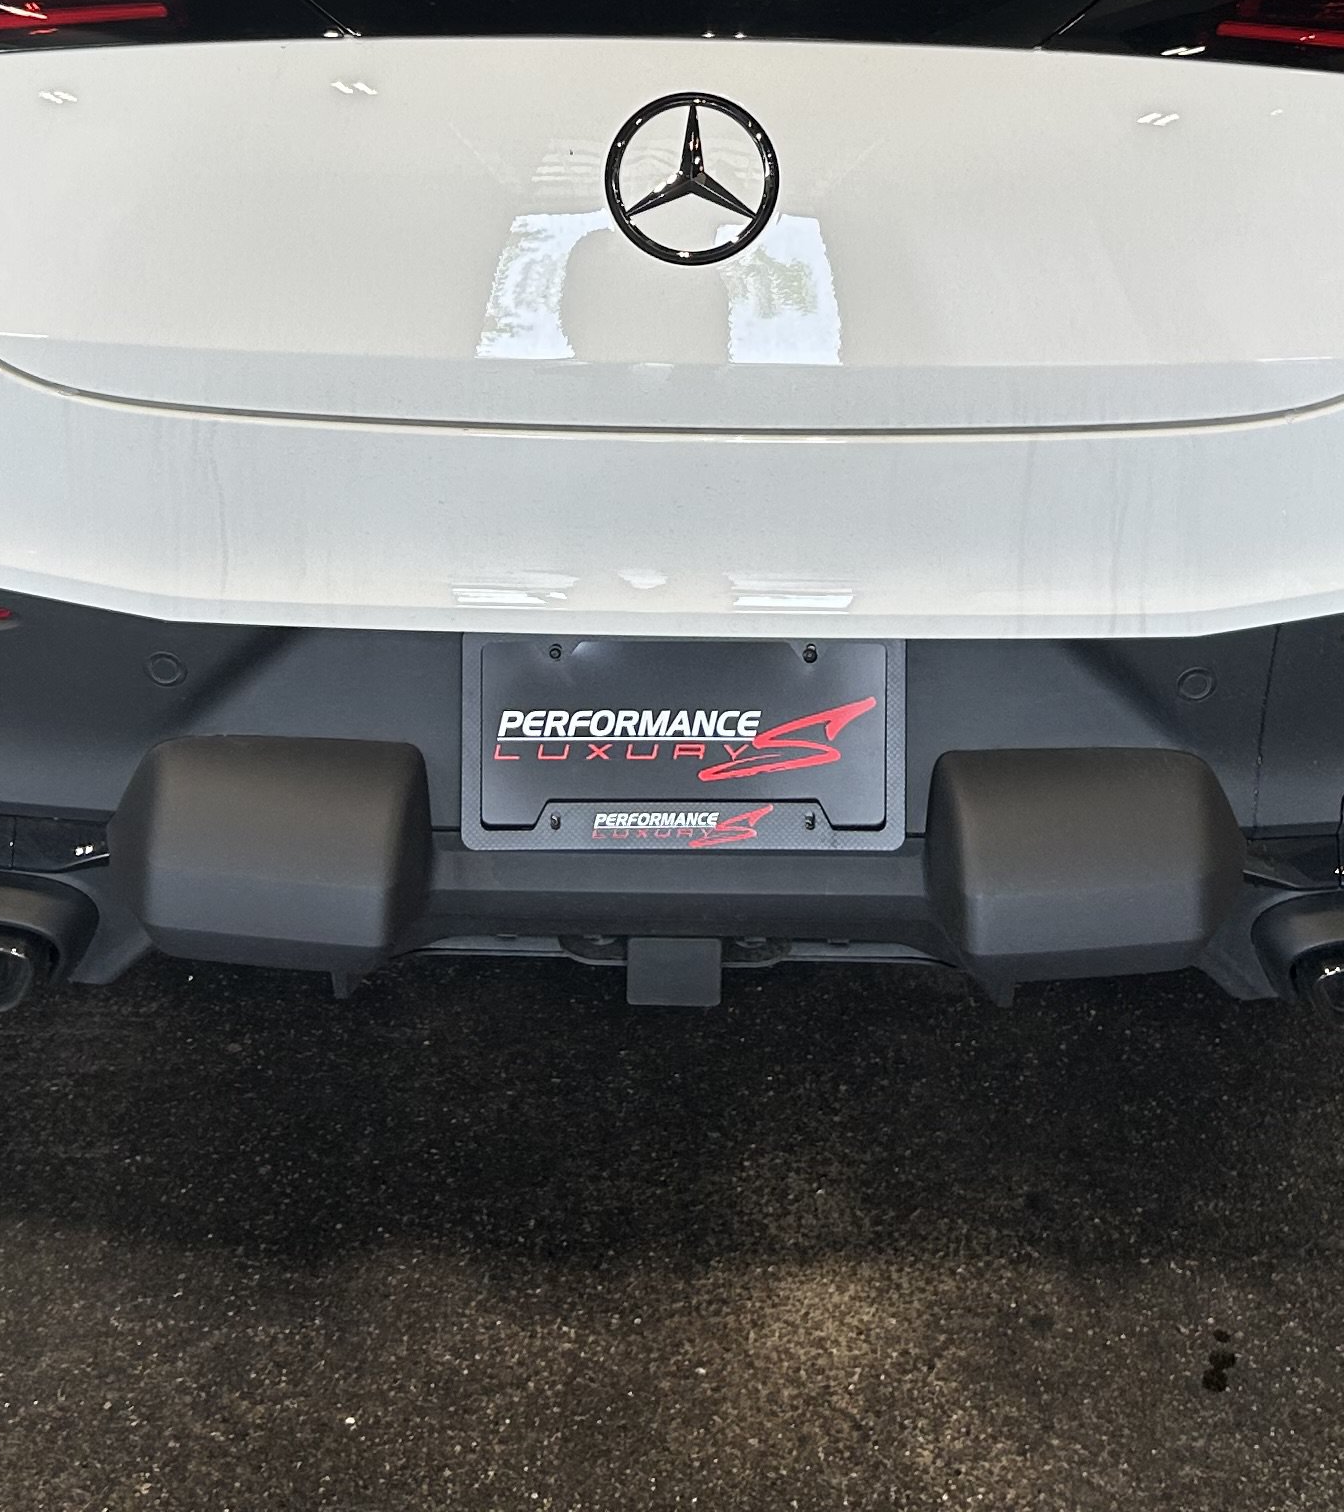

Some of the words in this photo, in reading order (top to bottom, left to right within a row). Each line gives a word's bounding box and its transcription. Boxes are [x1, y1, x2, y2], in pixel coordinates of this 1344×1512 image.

[497, 710, 762, 738] PERFORMANCE
[493, 743, 749, 761] LUXURY
[593, 812, 720, 827] PERFORMANCE
[591, 828, 714, 839] LUXURY
